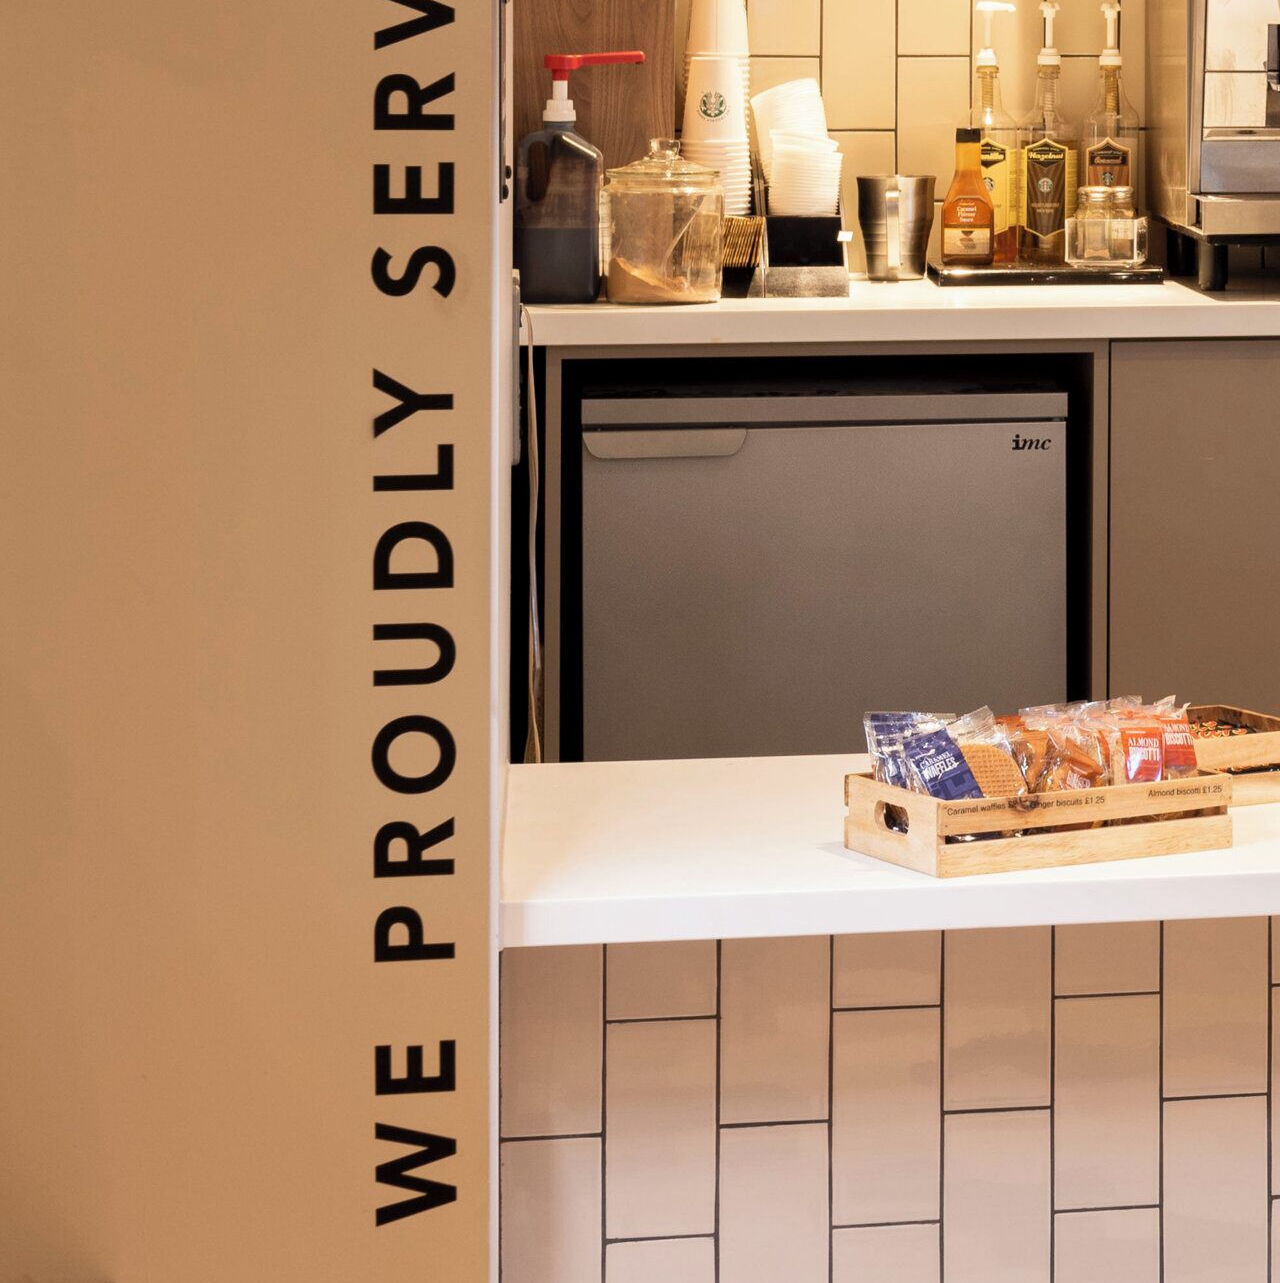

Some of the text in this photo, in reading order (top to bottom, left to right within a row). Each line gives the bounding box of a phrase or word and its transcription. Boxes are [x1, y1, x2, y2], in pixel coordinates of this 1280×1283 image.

[1028, 152, 1064, 161] Hazelnut
[1011, 434, 1052, 451] imc
[371, 368, 456, 962] PROUDLY
[1128, 738, 1159, 748] ALMOND
[1148, 785, 1223, 798] Almond biscotti £1.25
[1056, 796, 1105, 808] biscuits £1.25
[947, 804, 979, 816] Caramel
[980, 802, 1006, 812] waffles
[373, 1038, 456, 1226] WE
